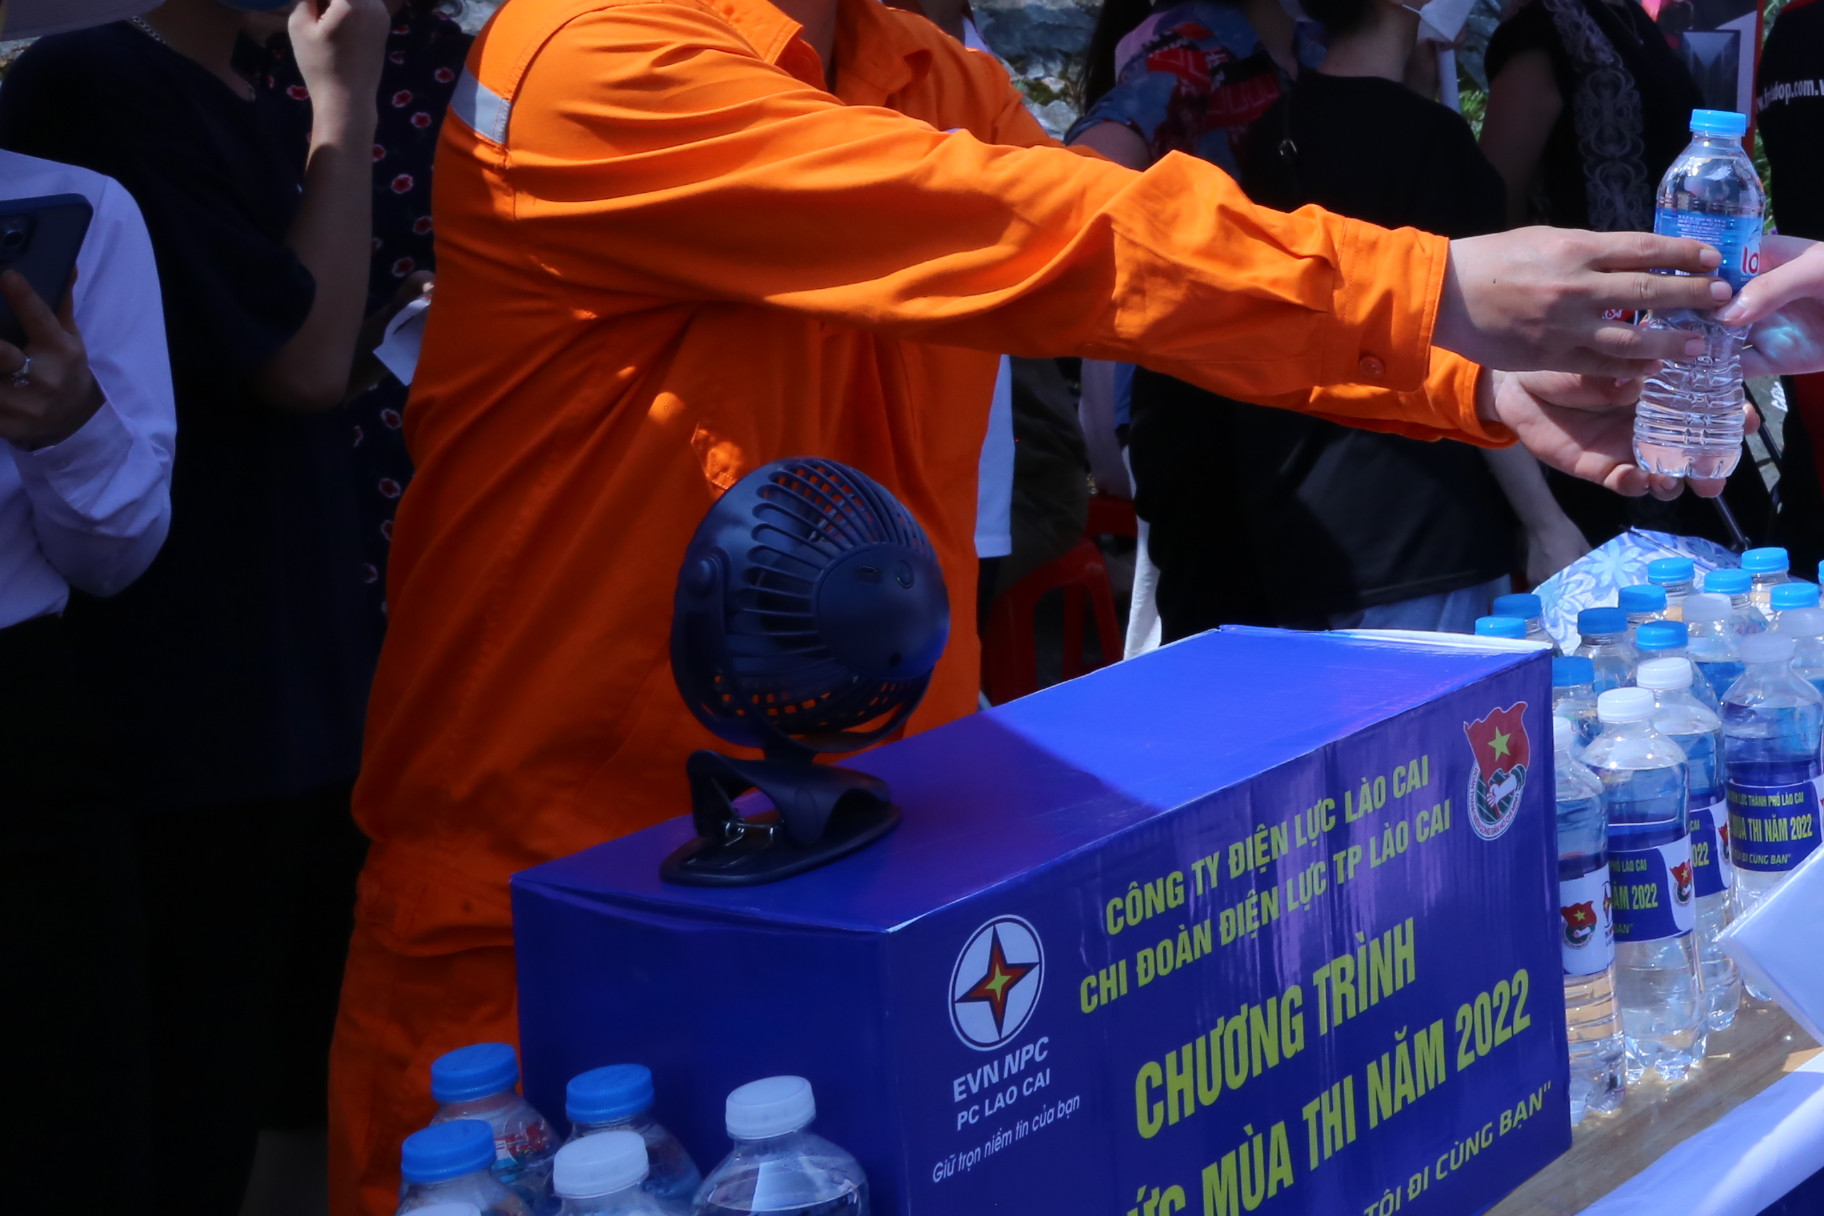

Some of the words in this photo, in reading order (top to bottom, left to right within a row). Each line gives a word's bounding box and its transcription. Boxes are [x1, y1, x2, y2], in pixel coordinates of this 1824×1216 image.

[1105, 870, 1185, 935] CÔNG
[1191, 851, 1221, 896] TY
[1228, 821, 1289, 873] ĐIỆN
[1295, 797, 1336, 848] LỰC
[1344, 775, 1386, 824] LÀO
[1392, 754, 1430, 799] CAI
[1747, 818, 1763, 842] THI
[1764, 813, 1789, 842] NĂM
[1790, 813, 1813, 840] 2022
[1079, 959, 1128, 1014] CHI
[1136, 919, 1213, 987] ĐOÀN
[1219, 886, 1280, 946] ĐIỆN
[1286, 861, 1327, 912] LỰC
[1332, 844, 1362, 885] TP
[1369, 819, 1409, 869] LÀO
[1415, 798, 1451, 844] CAI
[1612, 881, 1630, 910] ĂM
[1632, 883, 1659, 910] 2022
[952, 1059, 1000, 1102] EVN
[1003, 1036, 1049, 1079] NPC
[1134, 984, 1305, 1140] CHƯƠNG
[1312, 916, 1416, 1037] TRÌNH
[956, 1105, 980, 1131] PC
[984, 1085, 1018, 1117] LAO
[1022, 1068, 1050, 1096] CAI
[1201, 1120, 1294, 1216] MÙA
[1302, 1074, 1357, 1172] THI
[1366, 1025, 1446, 1131] NĂM
[1454, 968, 1531, 1073] 2022
[932, 1154, 957, 1183] Giữ
[957, 1146, 982, 1172] trọn
[983, 1128, 1013, 1159] niềm
[1015, 1119, 1029, 1141] tin
[1031, 1104, 1055, 1132] của
[1056, 1095, 1081, 1120] bạn
[1407, 1166, 1429, 1202] ĐI
[1435, 1122, 1493, 1180] CÙNG
